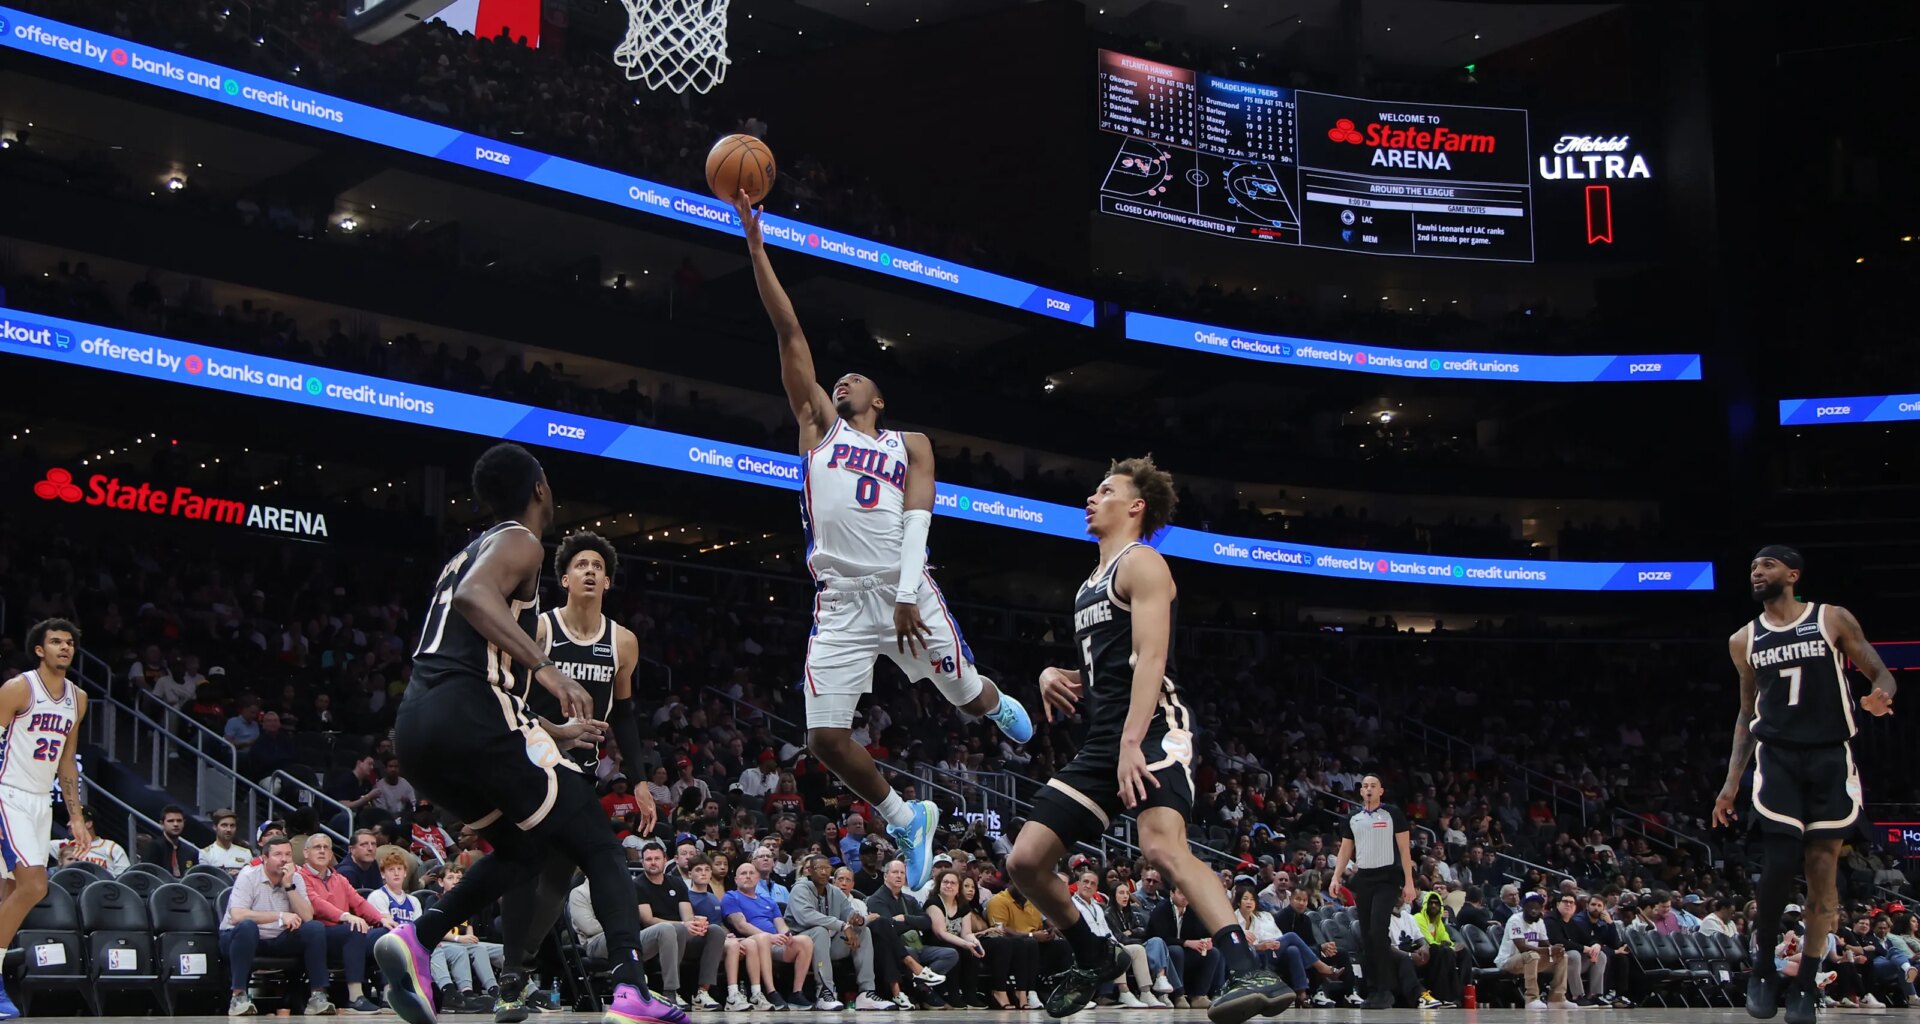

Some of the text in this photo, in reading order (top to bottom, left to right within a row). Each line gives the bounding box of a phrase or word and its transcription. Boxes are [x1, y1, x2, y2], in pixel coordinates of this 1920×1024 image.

[14, 25, 344, 123] offered by banks and credit unions
[1121, 58, 1173, 77] ATLANTA HAWKS
[1109, 75, 1137, 87] Okongwu
[1109, 84, 1133, 95] Johnson
[1166, 79, 1175, 87] AST
[1211, 80, 1278, 98] PHILADELPHIA 76ERS
[1109, 93, 1139, 105] McCollum
[1109, 103, 1132, 113] Daniels
[1206, 97, 1240, 110] Drummond
[1206, 106, 1227, 118] Barlow
[1206, 116, 1225, 126] Maxey
[1379, 112, 1440, 124] WELCOME TO
[1206, 125, 1224, 134] Oubre
[1365, 122, 1495, 153] State Farm
[1207, 134, 1228, 144] Grimes
[1553, 135, 1630, 154] Michelob
[475, 147, 511, 165] paze
[1371, 149, 1451, 171] ARENA
[1539, 154, 1651, 180] ULTRA
[1370, 185, 1454, 197] AROUND THE LEAGUE
[1115, 202, 1236, 234] CLOSED CAPTIONING PRESENTED BY
[1362, 216, 1373, 224] LAC
[628, 186, 671, 208] Online
[673, 198, 731, 224] checkout
[791, 228, 806, 246] by
[820, 236, 856, 257] banks
[856, 248, 879, 263] and
[892, 258, 924, 274] credit
[924, 266, 959, 284] unions
[1416, 224, 1505, 235] Kawhi Leonard of LAC ranks
[1362, 235, 1378, 243] MEM
[1438, 234, 1458, 244] steals
[1459, 236, 1470, 245] per
[1471, 237, 1491, 246] game.
[1046, 298, 1071, 312] paze
[1194, 331, 1520, 373] Online checkout offered by banks and credit unions
[80, 337, 154, 365] offered
[156, 348, 182, 373] by
[207, 358, 264, 385] banks
[266, 373, 303, 391] and
[325, 383, 376, 404] credit
[378, 391, 434, 414] unions
[1629, 363, 1662, 374] paze
[1817, 406, 1851, 417] paze
[547, 422, 586, 440] paze
[688, 447, 799, 480] Online checkout
[856, 476, 880, 508] 0
[86, 474, 328, 537] State Farm ARENA
[934, 493, 1044, 523] and credit unions
[1213, 542, 1547, 581] Online checkout offered by banks and credit unions
[1638, 571, 1672, 583] paze
[1082, 635, 1094, 687] 5
[1752, 640, 1826, 669] PEACHTREE
[554, 660, 614, 682] EACHTREE
[930, 656, 955, 674] 76
[1778, 666, 1802, 706] 7
[33, 738, 62, 762] 25
